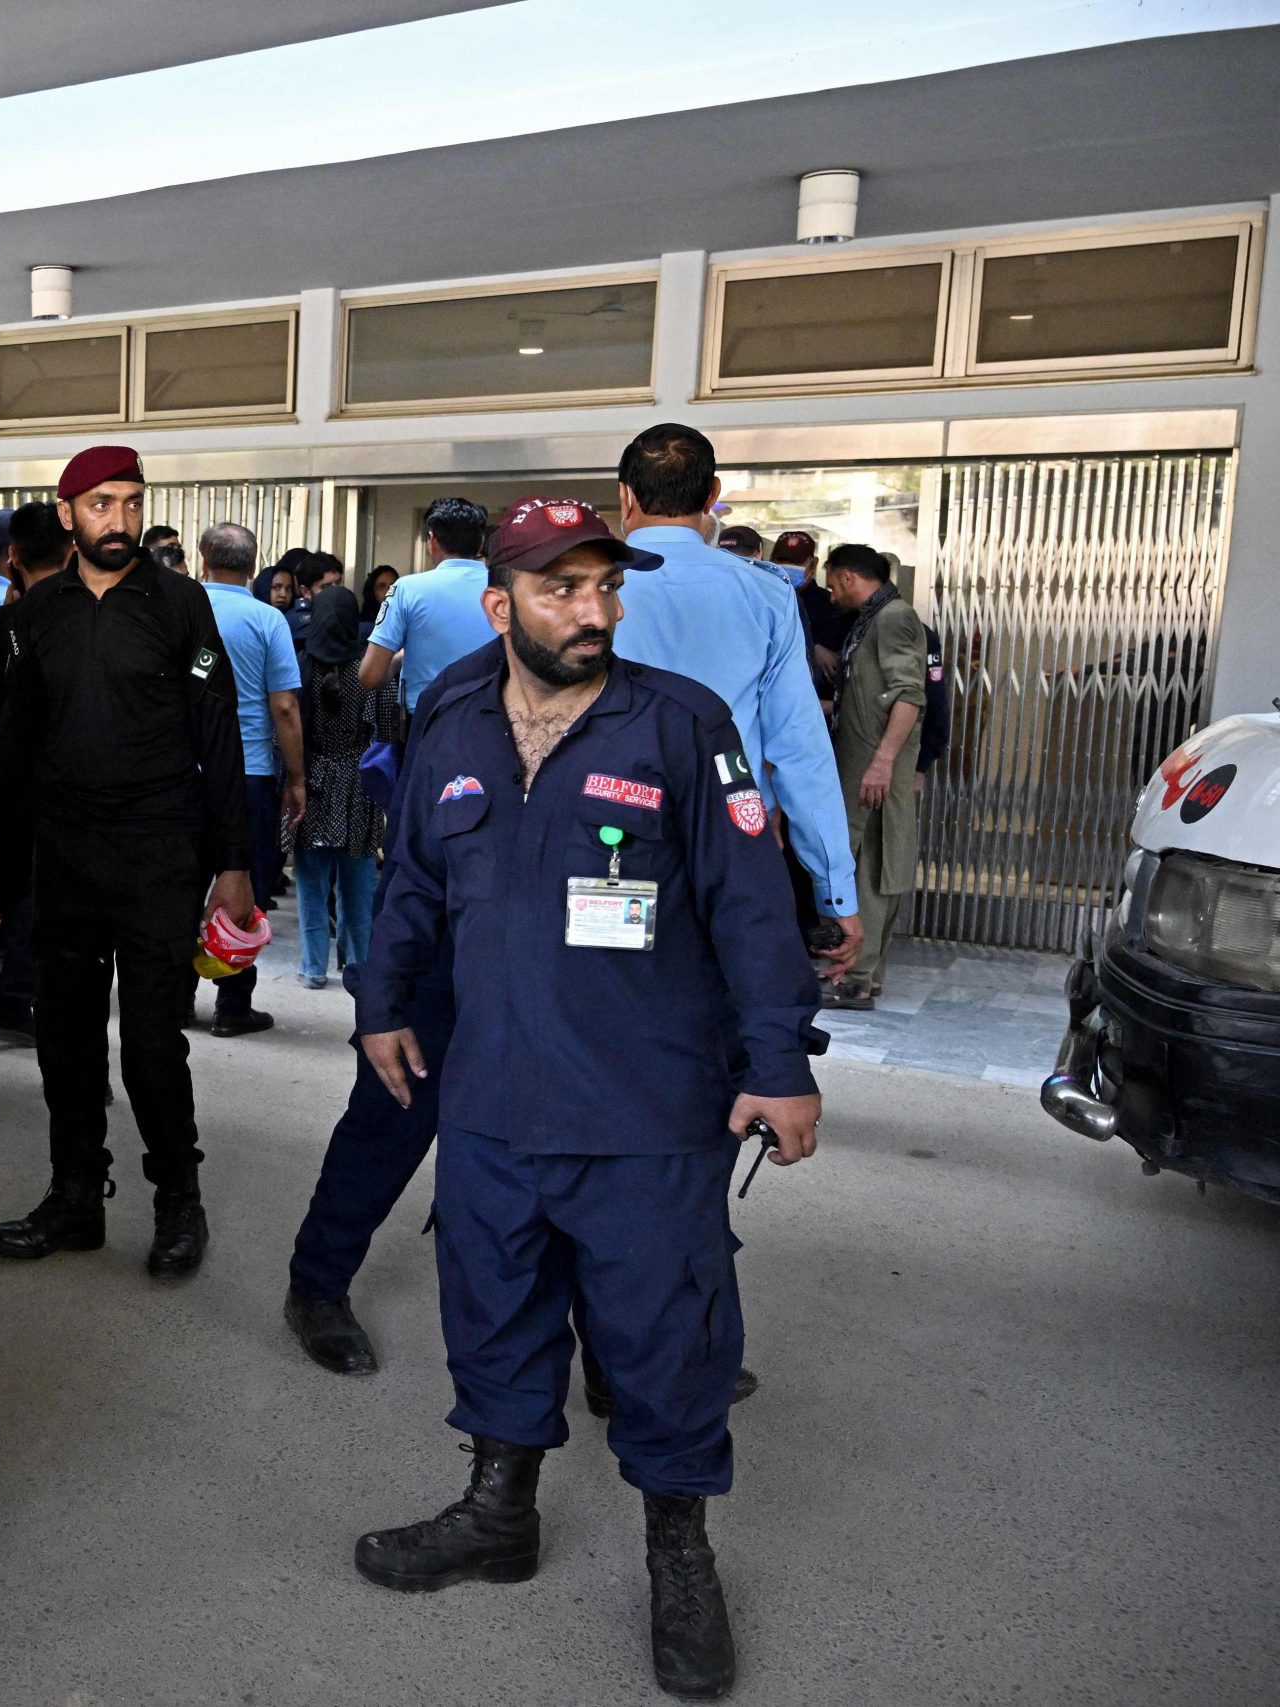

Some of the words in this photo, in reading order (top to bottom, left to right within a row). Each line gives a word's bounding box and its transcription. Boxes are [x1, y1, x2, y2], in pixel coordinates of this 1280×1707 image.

[584, 787, 621, 800] SECURITY
[624, 794, 657, 808] SERVICES
[587, 775, 662, 800] BELFORT
